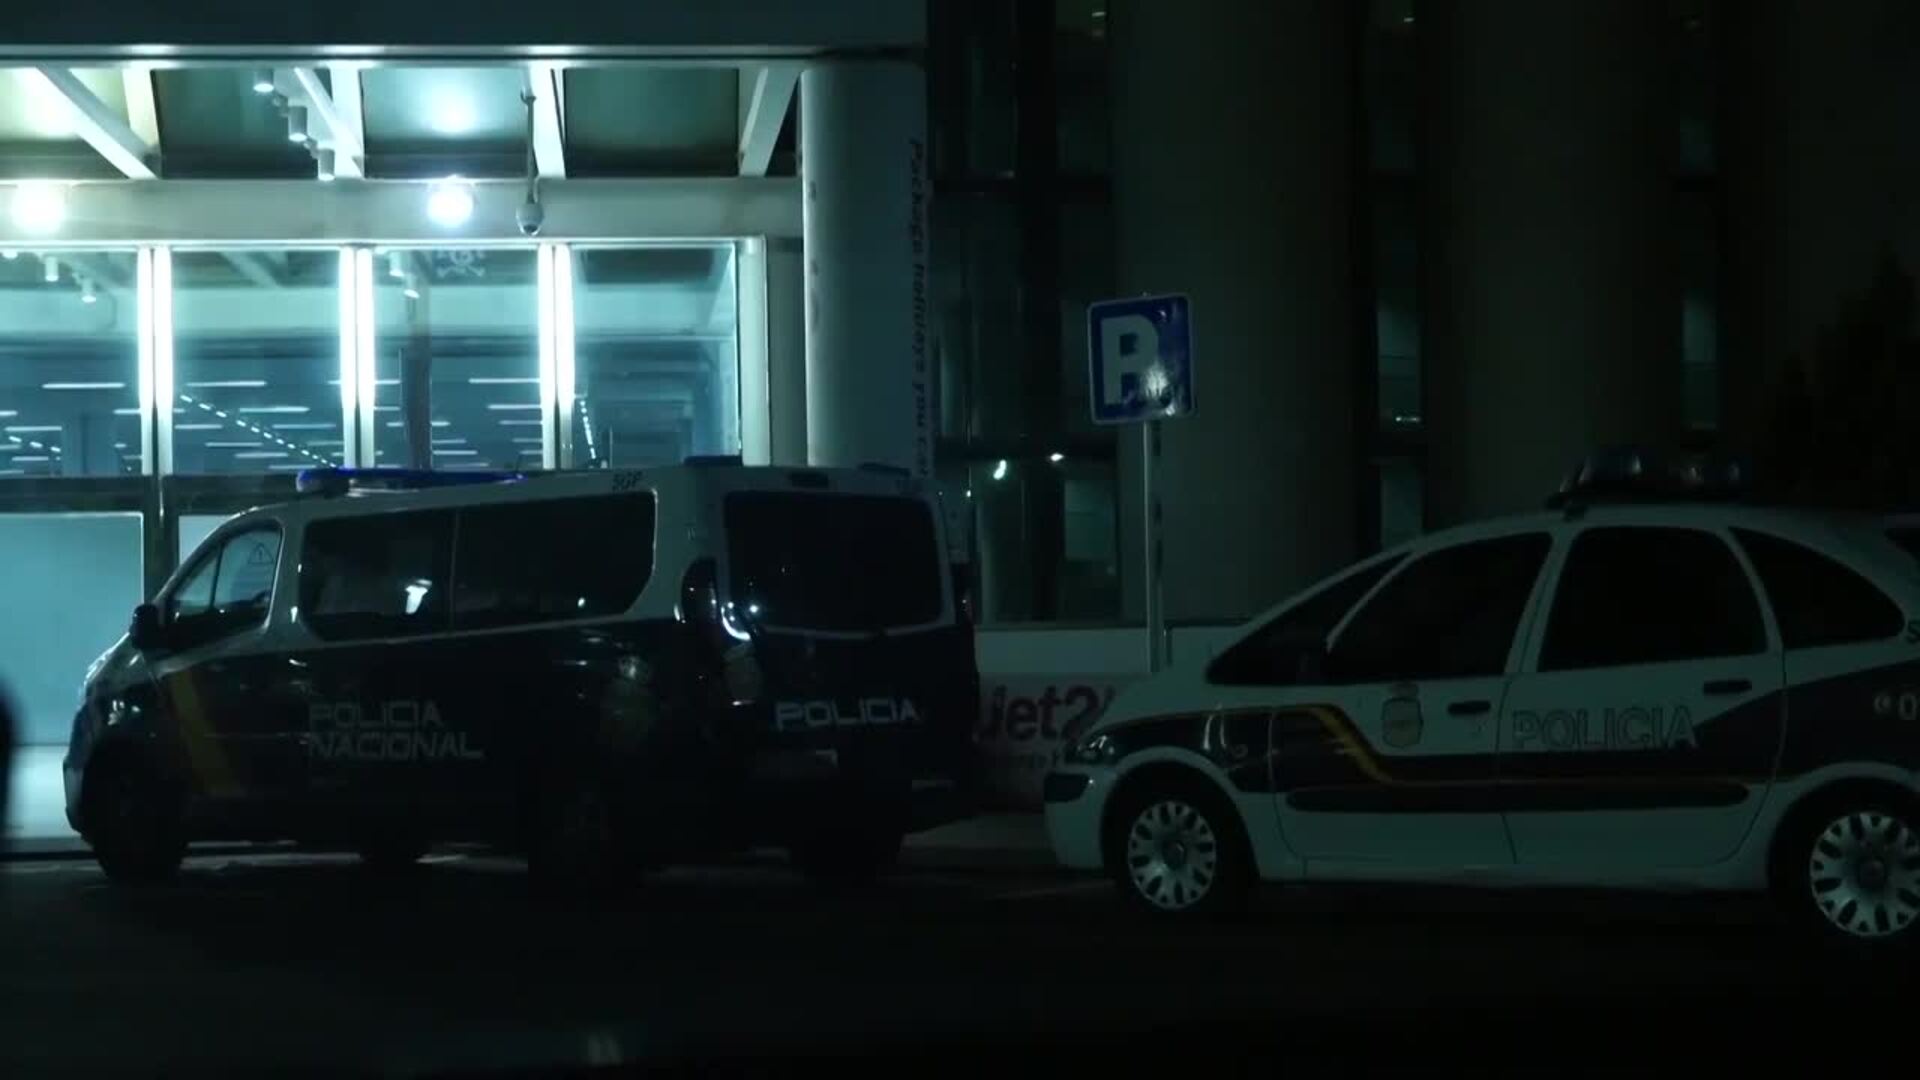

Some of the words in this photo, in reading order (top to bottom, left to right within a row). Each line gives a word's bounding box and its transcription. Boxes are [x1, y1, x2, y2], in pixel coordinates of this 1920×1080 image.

[912, 263, 927, 373] holidays
[309, 700, 444, 728] POLICIA
[774, 697, 922, 732] POLICIA
[975, 684, 1115, 744] Jet2
[1512, 704, 1697, 750] POLICIA
[309, 731, 485, 760] NACIONAL
